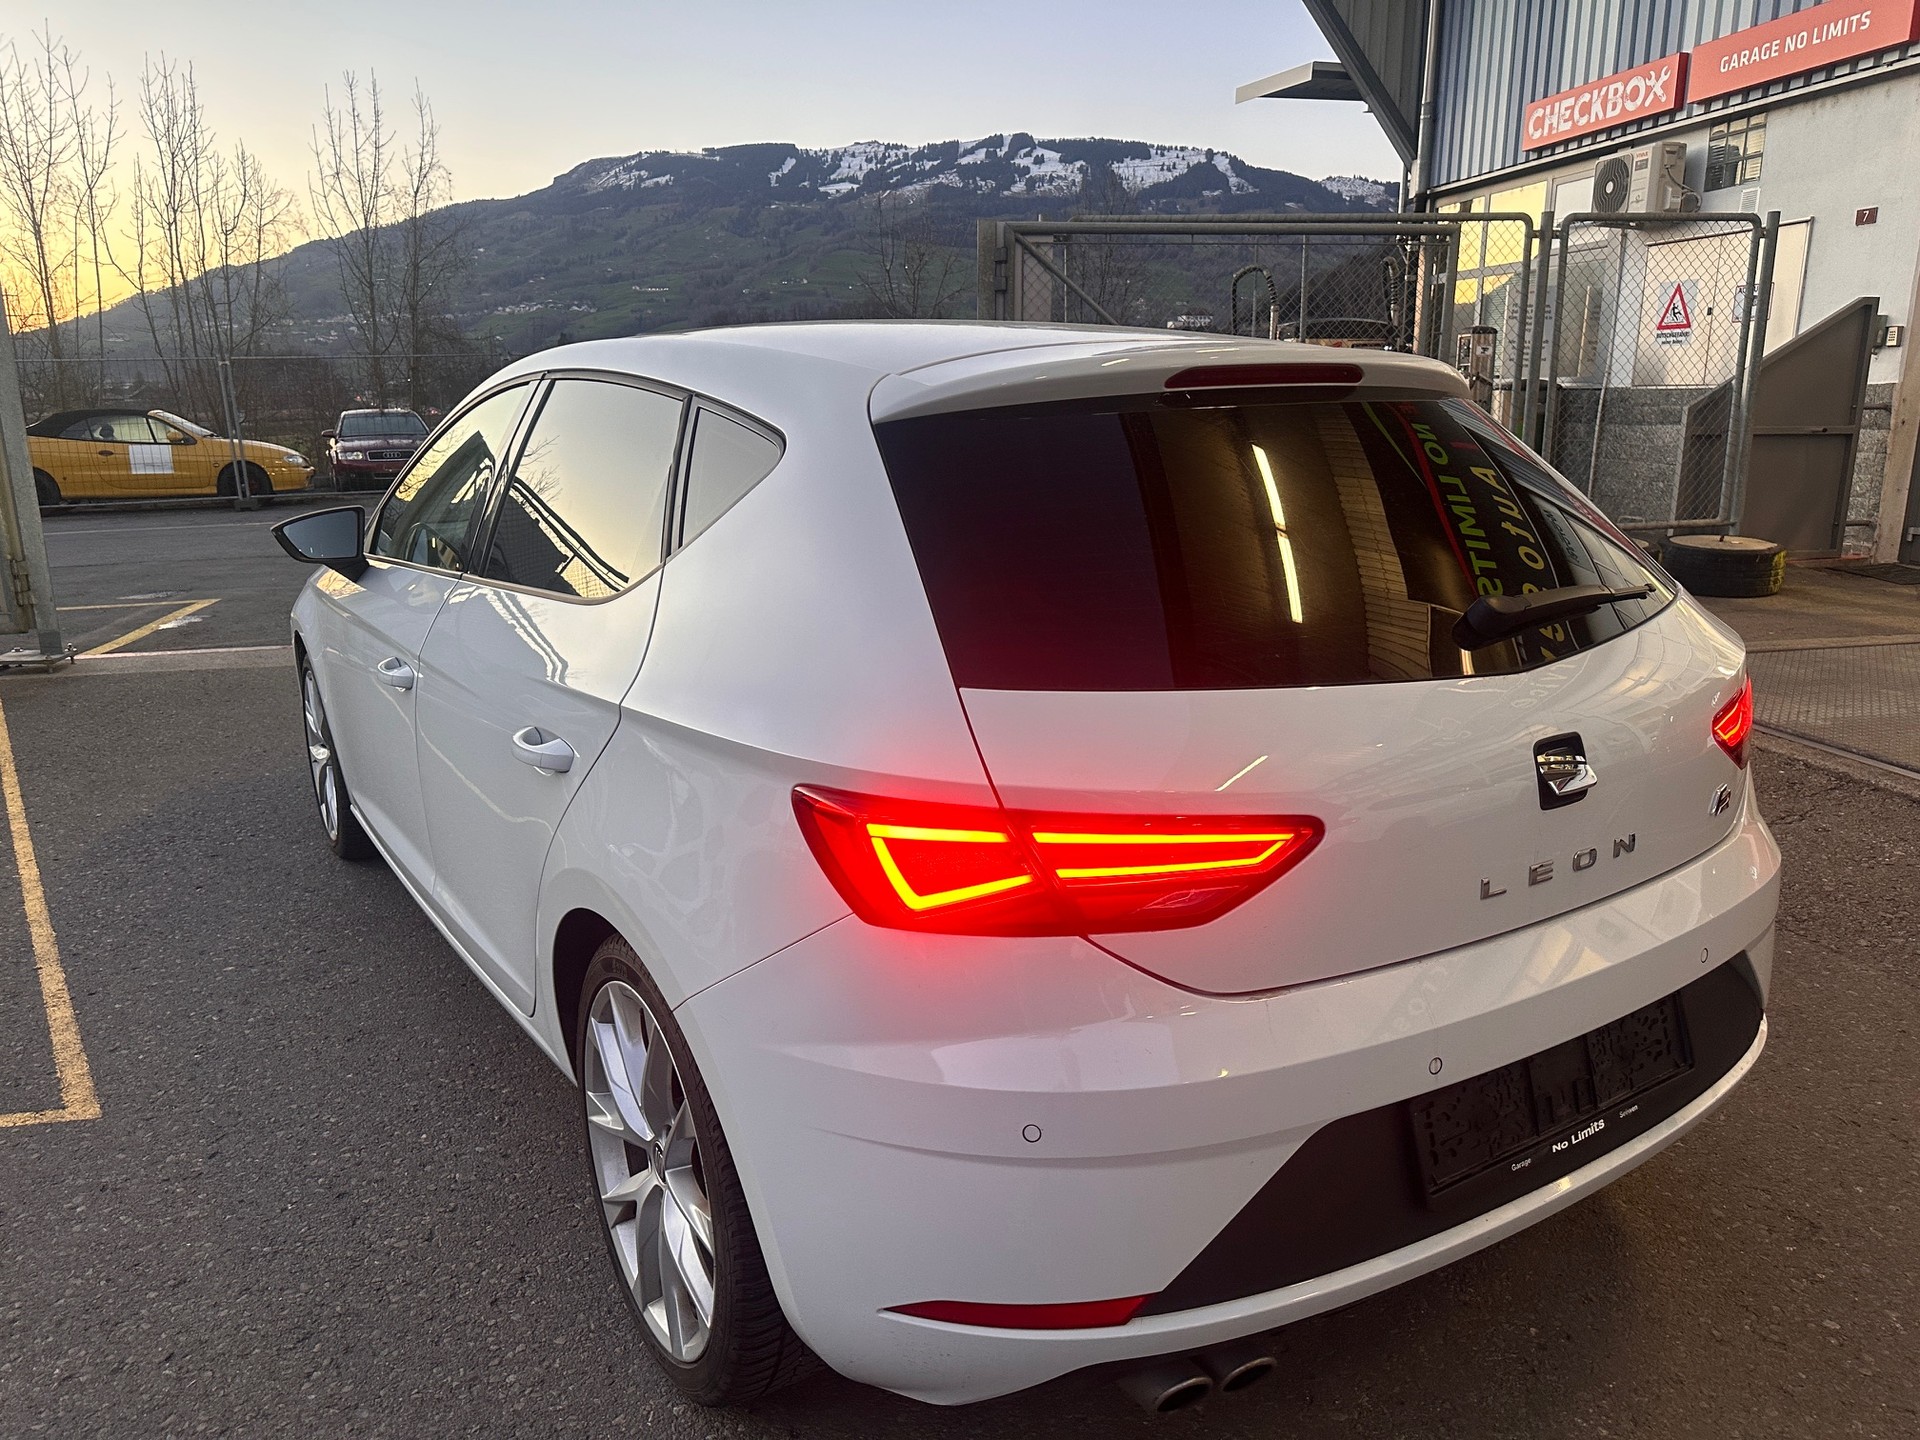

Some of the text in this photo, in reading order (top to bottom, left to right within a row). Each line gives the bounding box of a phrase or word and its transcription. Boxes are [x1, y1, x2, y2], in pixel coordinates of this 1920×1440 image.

[1719, 10, 1872, 74] GARAGE NO LIMITS
[1528, 65, 1672, 140] CHECKBOX
[1862, 210, 1870, 223] 7
[1480, 832, 1636, 900] LEON
[1511, 1158, 1532, 1172] Garage
[1552, 1141, 1569, 1153] No
[1571, 1119, 1605, 1144] Limits
